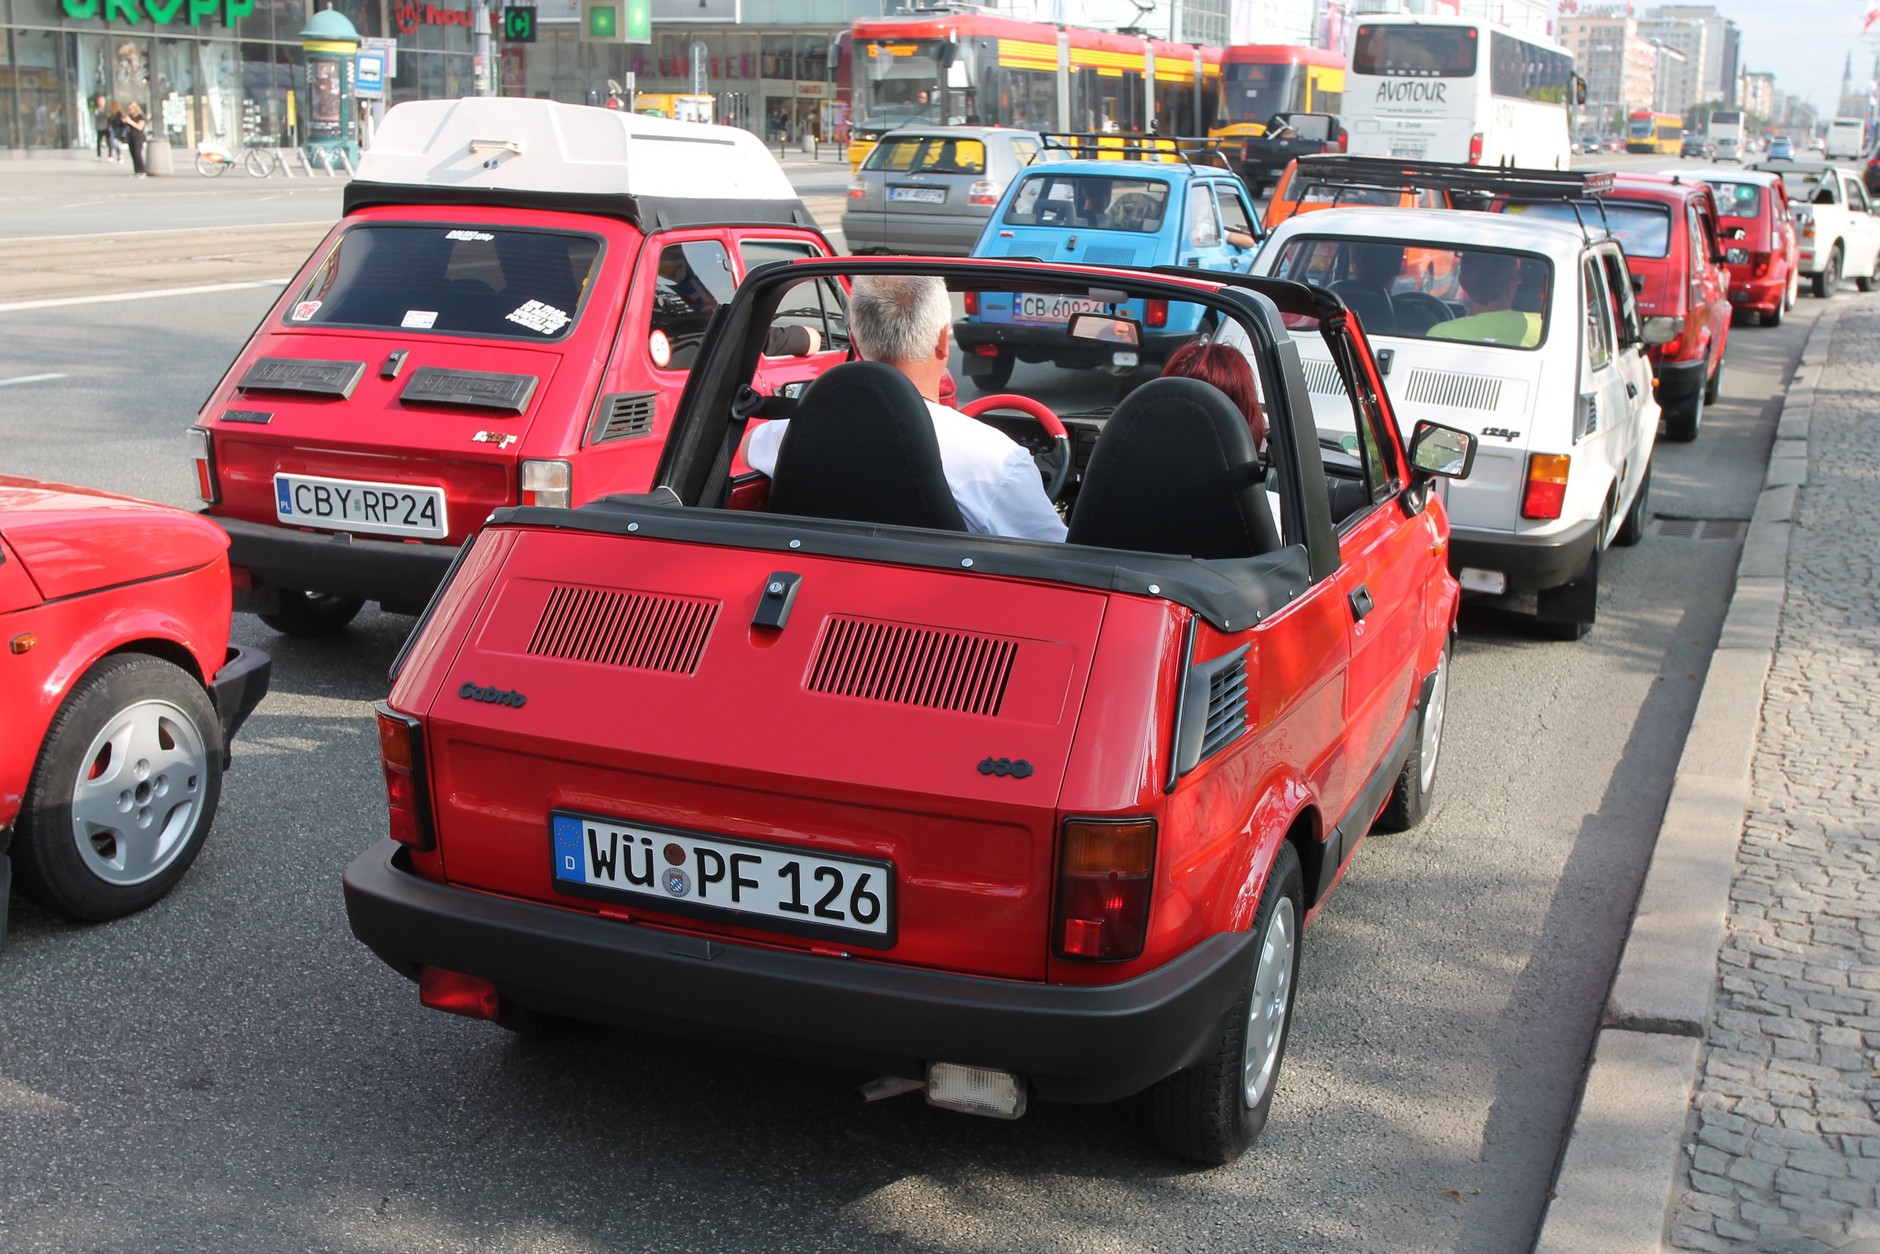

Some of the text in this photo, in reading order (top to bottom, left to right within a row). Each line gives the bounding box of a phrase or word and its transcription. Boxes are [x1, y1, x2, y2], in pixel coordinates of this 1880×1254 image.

[1375, 81, 1447, 103] AVOTOUR
[1024, 298, 1046, 316] CB
[295, 484, 437, 527] CBY RP24
[459, 682, 527, 708] Cabrio
[977, 757, 1034, 779] 650
[565, 856, 576, 870] D
[587, 828, 655, 887] WÜ
[694, 847, 762, 902] PF
[778, 861, 881, 924] 126
